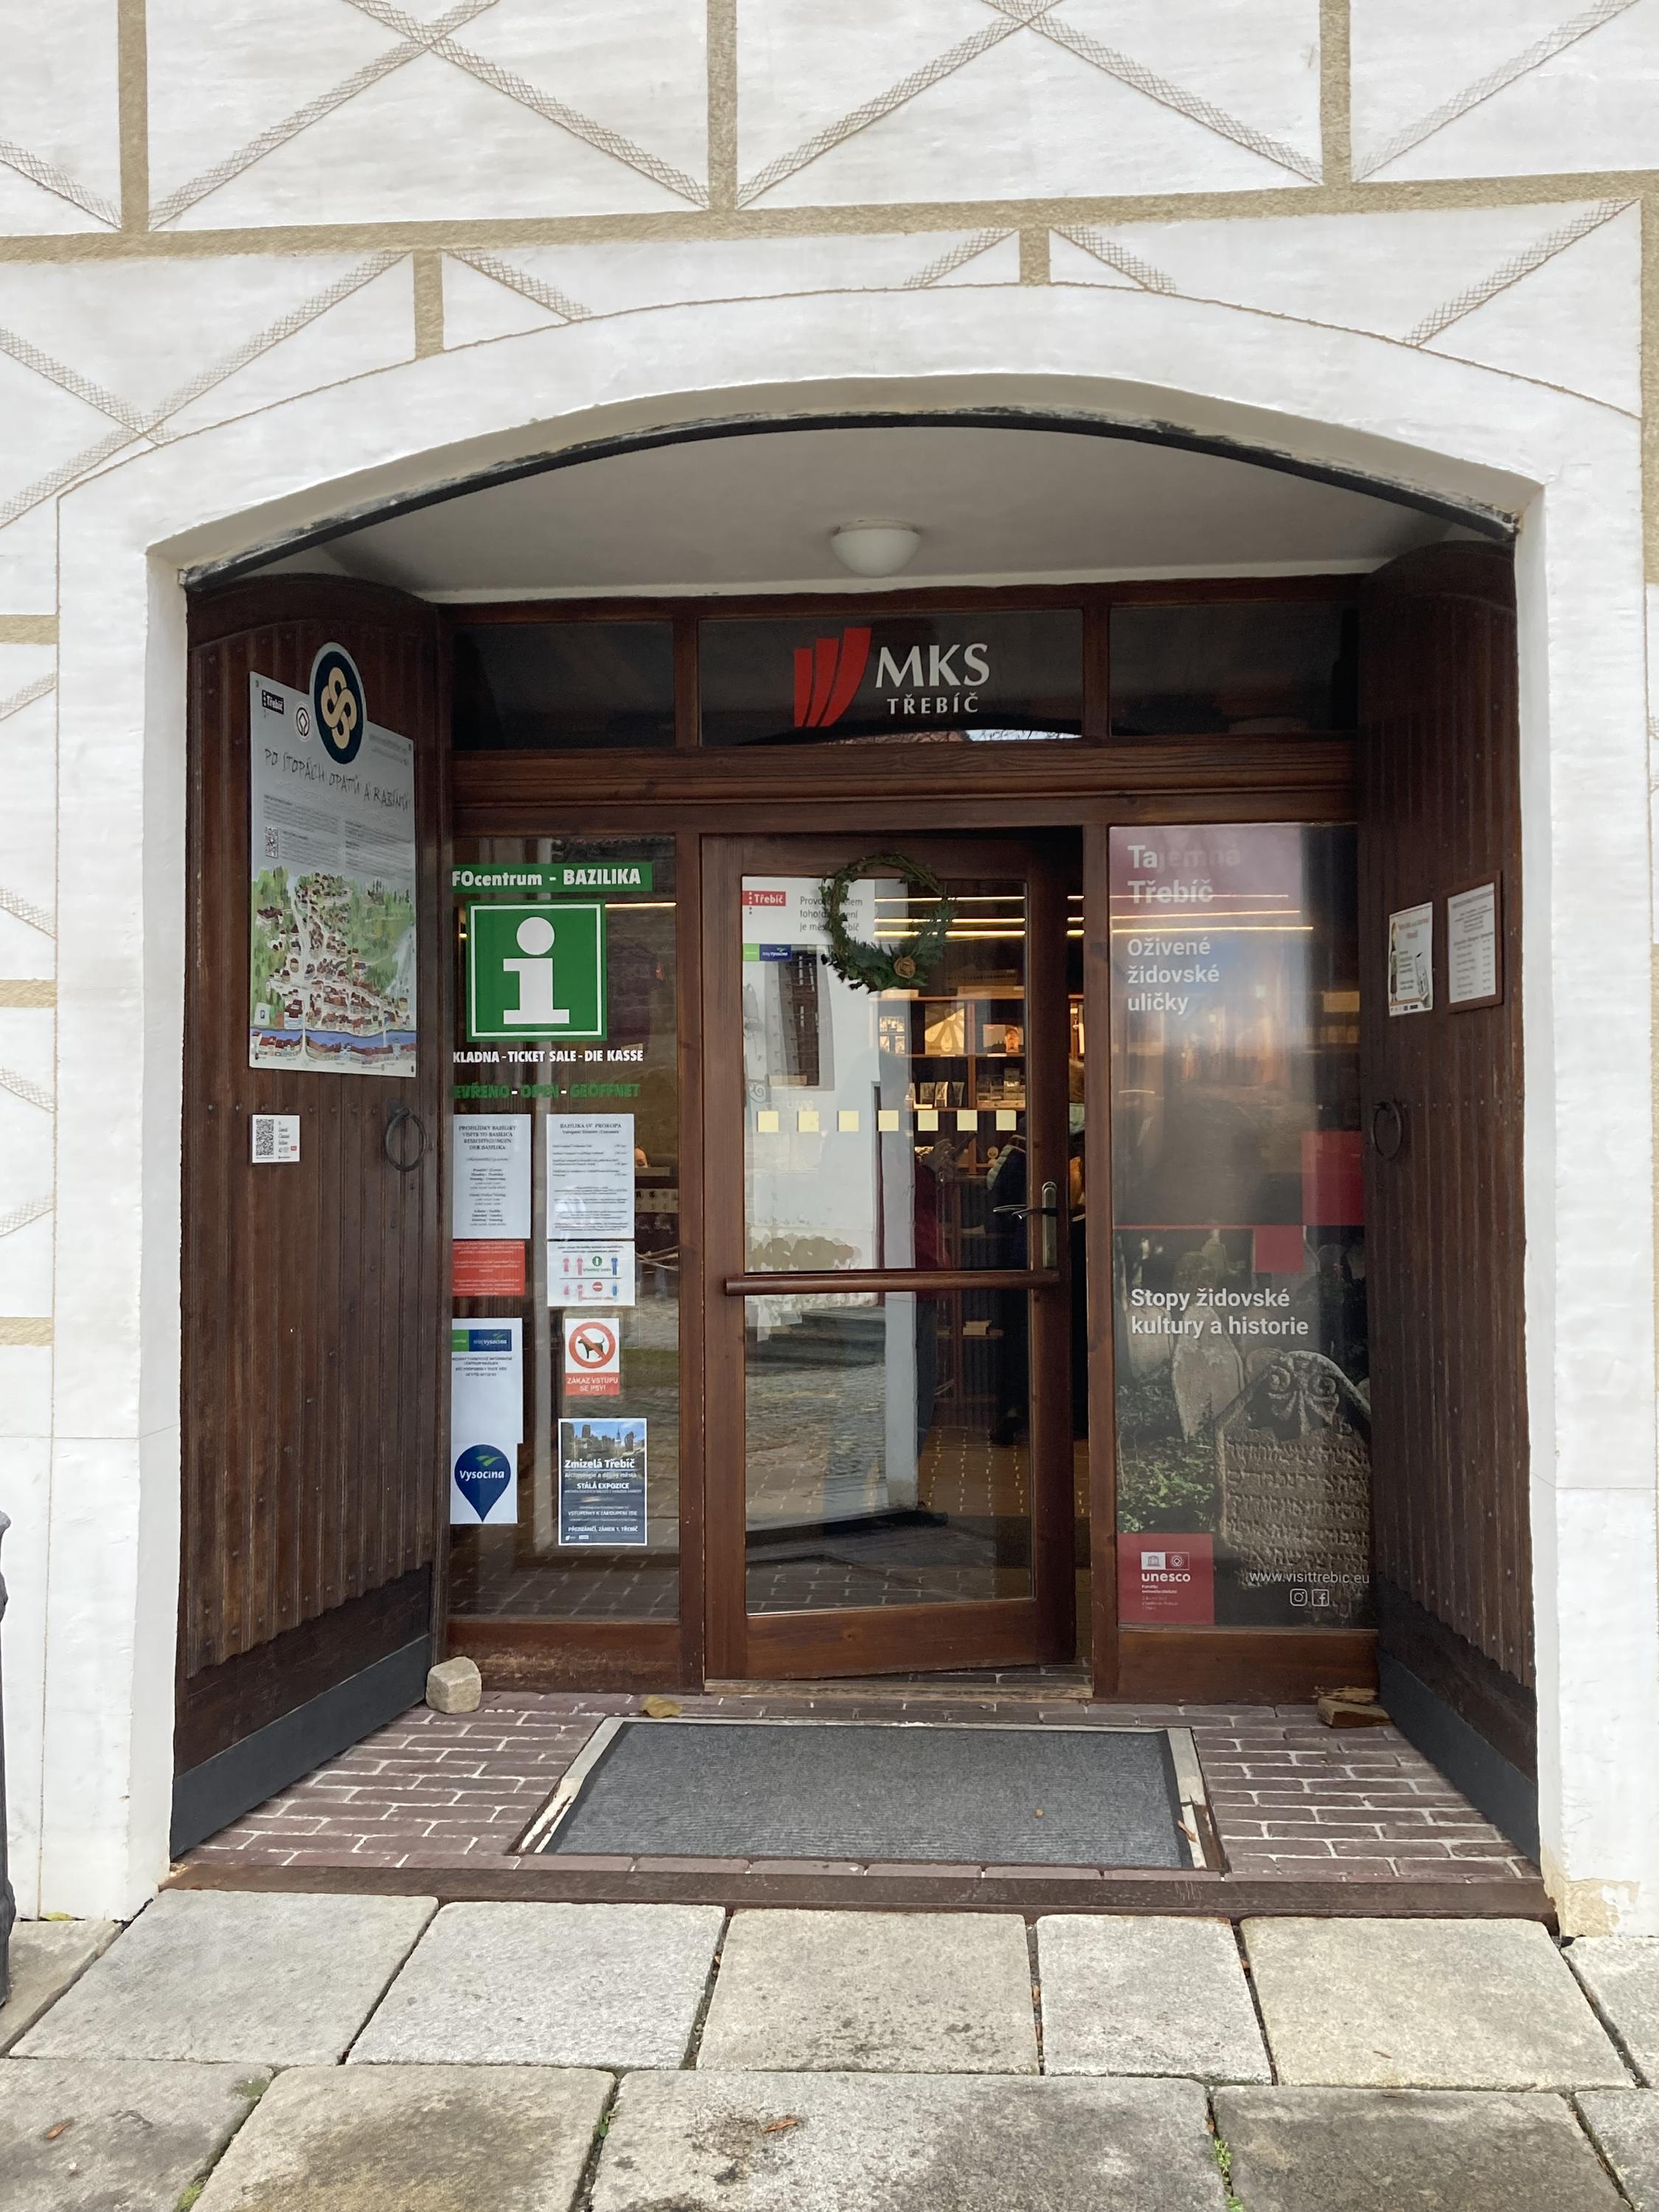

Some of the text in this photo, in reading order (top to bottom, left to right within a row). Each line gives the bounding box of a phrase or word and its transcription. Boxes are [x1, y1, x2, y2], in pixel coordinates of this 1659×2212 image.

[875, 643, 990, 688] MKS
[887, 692, 978, 714] TŘEBÍČ
[265, 748, 279, 765] PO
[364, 782, 370, 801] A
[563, 868, 641, 885] BAZILIKA
[754, 893, 783, 903] Třebíč
[1127, 879, 1213, 903] Třebíč
[799, 923, 807, 932] je
[1127, 936, 1211, 956] Oživené
[1127, 964, 1220, 984] židovské
[1127, 990, 1189, 1015] uličky
[453, 1051, 500, 1063] KLADNA
[507, 1051, 545, 1062] TICKET
[549, 1050, 577, 1062] SALE
[585, 1050, 603, 1062] DIE
[607, 1050, 644, 1062] KASSE
[521, 1085, 559, 1098] OPEN
[1131, 1288, 1290, 1311] Stopy židovské
[1131, 1316, 1309, 1339] kultury a historie
[564, 1458, 635, 1468] Zmizelá Třebíč
[1141, 1573, 1191, 1582] unesco
[1249, 1571, 1370, 1584] www.visittrebic.eu
